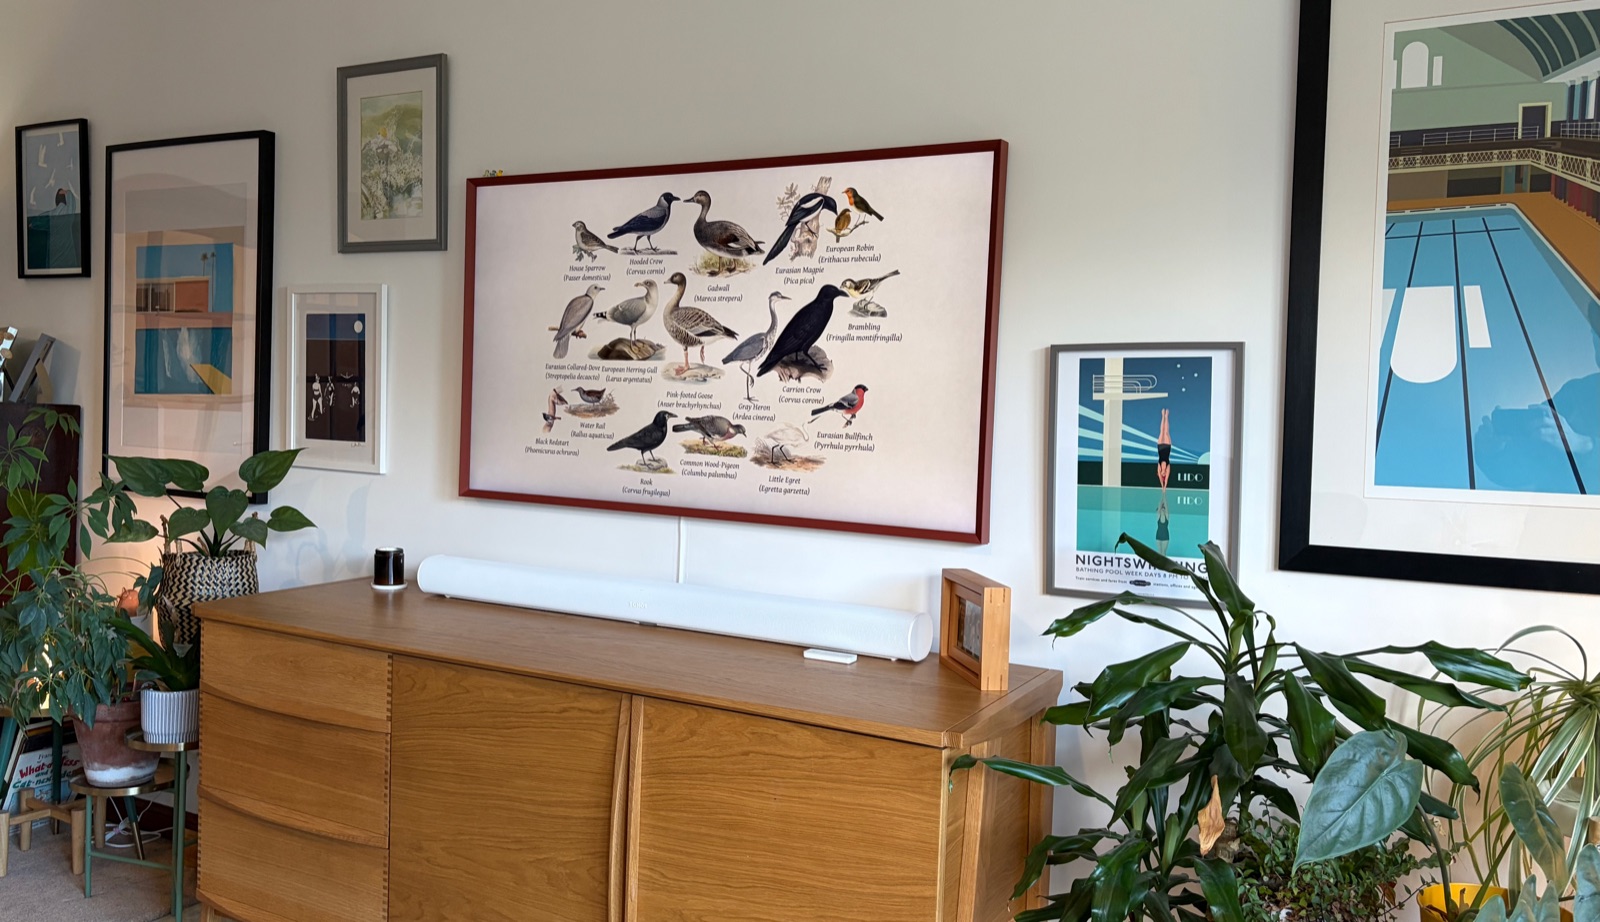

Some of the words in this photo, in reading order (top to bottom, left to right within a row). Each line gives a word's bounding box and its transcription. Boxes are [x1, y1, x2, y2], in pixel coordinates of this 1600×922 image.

[826, 245, 855, 254] European
[856, 244, 874, 252] Robin
[629, 258, 648, 266] Hooded
[818, 255, 850, 264] (Erithacus
[851, 254, 881, 263] rubecula)
[626, 268, 648, 276] (Corvus
[649, 267, 666, 275] cornix)
[802, 266, 824, 275] Magpie
[563, 274, 581, 282] (Passer
[582, 273, 611, 282] domesticus)
[784, 277, 799, 285] (Pica
[800, 276, 815, 285] pica)
[708, 284, 730, 292] Gadwall
[694, 294, 717, 303] (Mareca
[717, 294, 743, 303] strepera)
[848, 323, 881, 332] Brambling
[826, 334, 854, 342] (Fringilla
[855, 334, 903, 342] montifringilla)
[602, 366, 625, 375] European
[626, 366, 646, 375] Herring
[646, 366, 658, 374] Gull
[606, 375, 622, 383] (Larus
[622, 376, 652, 384] argentatus)
[782, 386, 805, 394] Carrion
[806, 386, 822, 394] Crow
[666, 391, 697, 399] Pink-footed
[697, 392, 713, 400] Goose
[778, 396, 801, 404] (Corvus
[802, 397, 825, 405] corone)
[676, 402, 722, 410] brachyrhynchus)
[738, 403, 752, 412] Gray
[732, 412, 752, 421] (Ardea
[752, 413, 776, 422] cinerea)
[817, 431, 844, 440] Eurasian
[844, 432, 873, 441] Bullfinch
[814, 442, 844, 451] (Pyrrhula
[844, 443, 875, 452] pyrrhula)
[680, 458, 704, 467] Common
[704, 461, 740, 470] Wood-Pigeon
[681, 469, 707, 477] (Columba
[708, 471, 737, 480] palumbus)
[1177, 472, 1204, 482] LIDO
[640, 478, 653, 486] Rook
[768, 475, 784, 484] Little
[785, 476, 801, 485] Egret
[622, 486, 642, 494] (Corvus
[642, 487, 671, 497] frugilegus)
[758, 484, 782, 494] (Egretta
[783, 486, 810, 496] garzetta)
[1075, 554, 1208, 574] NIGHTSWING
